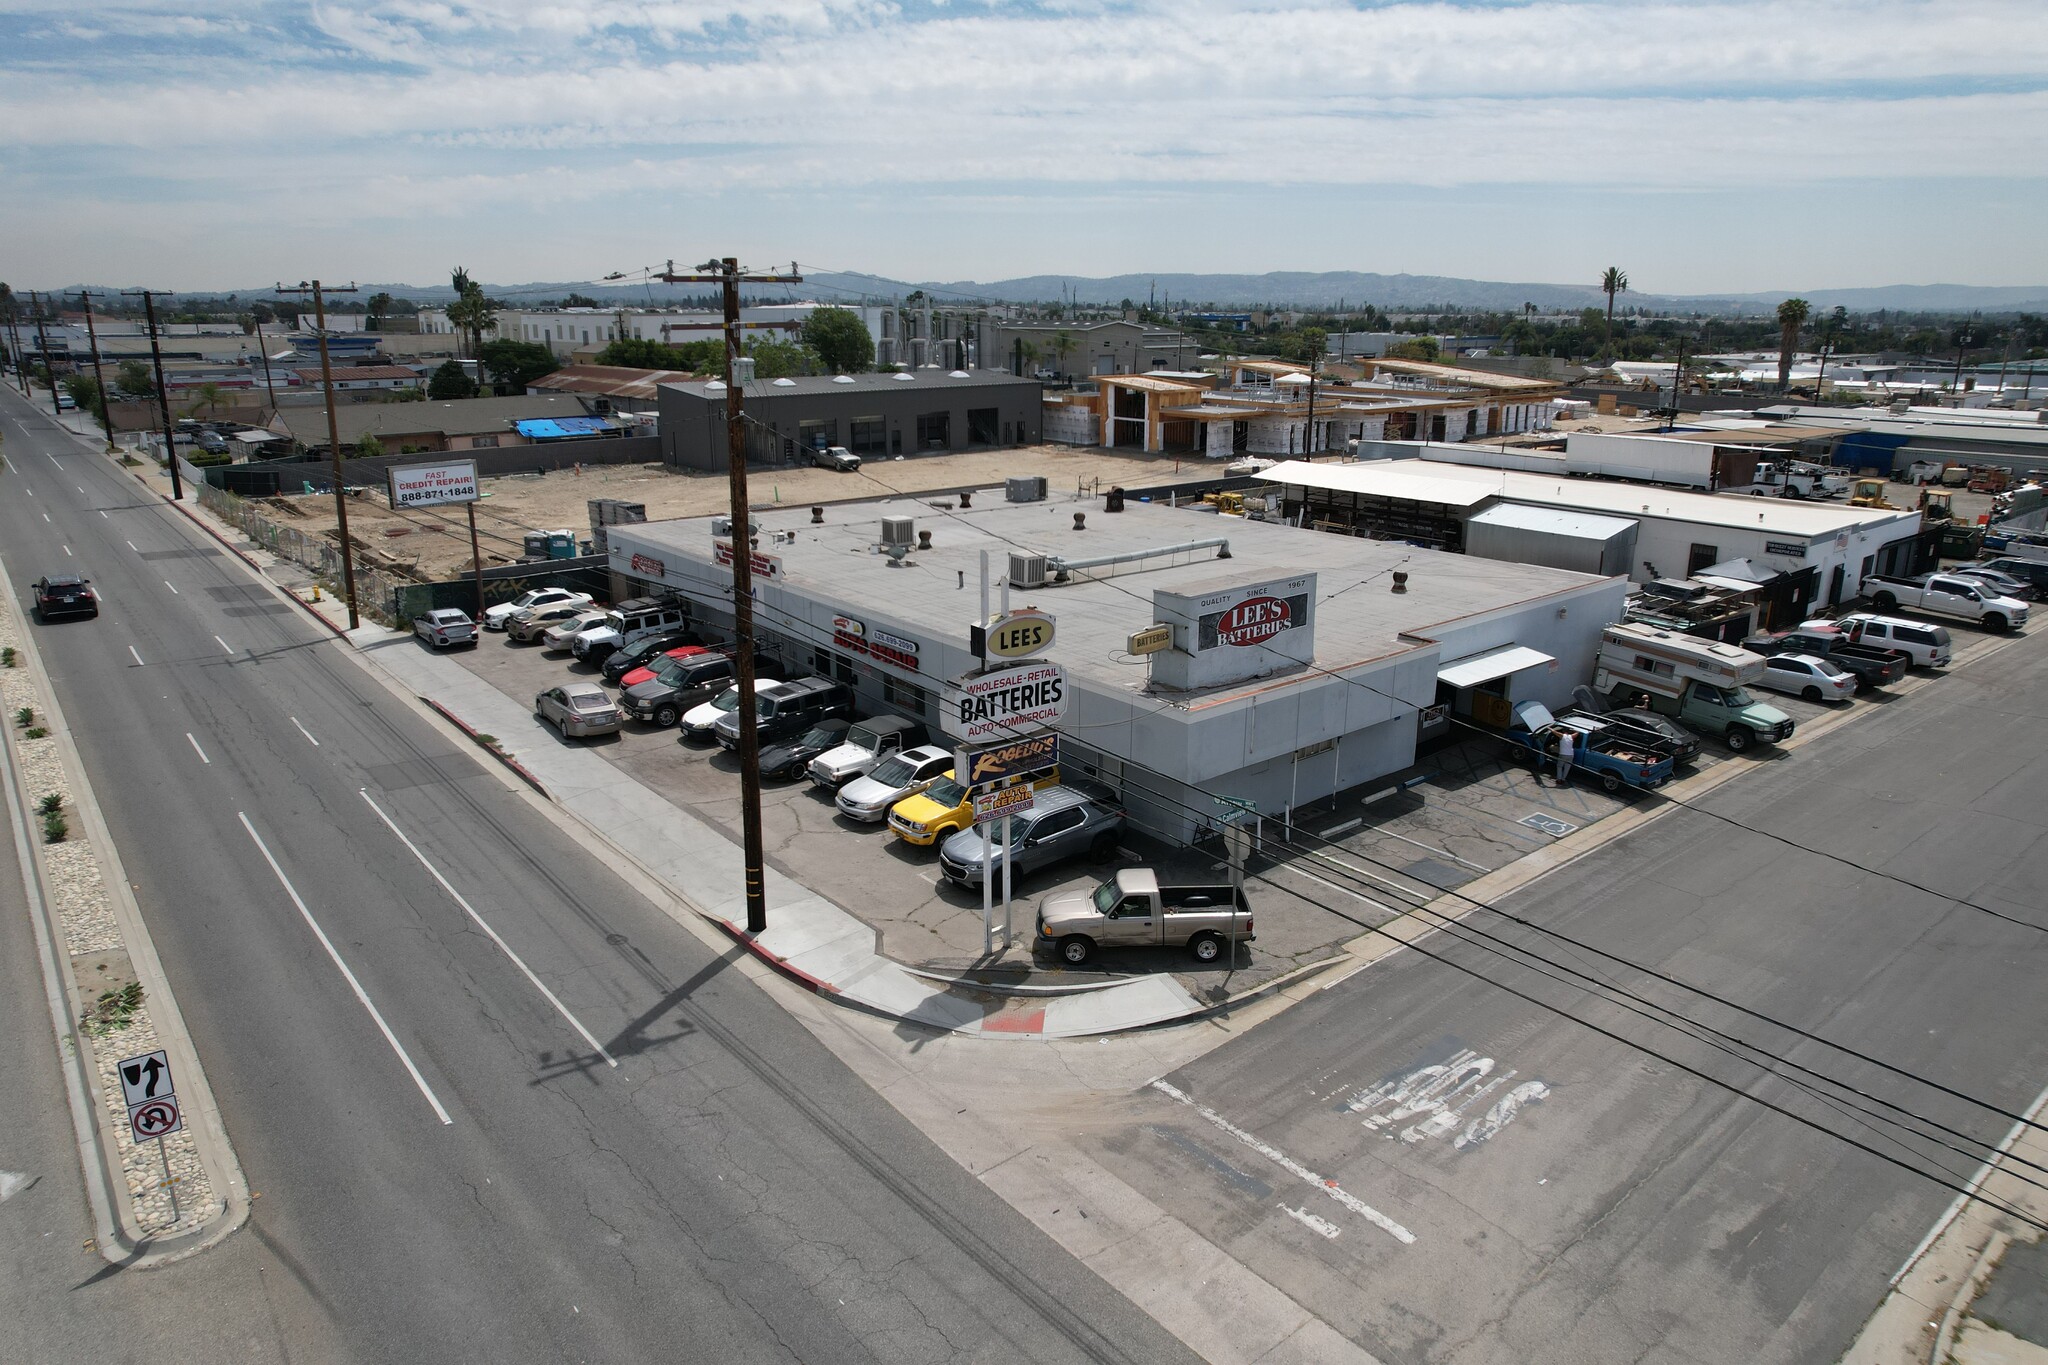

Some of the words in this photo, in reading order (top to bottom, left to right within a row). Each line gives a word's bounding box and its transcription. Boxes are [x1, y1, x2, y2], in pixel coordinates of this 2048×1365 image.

[399, 480, 433, 490] CREDIT
[436, 476, 473, 487] REPAIR!
[425, 470, 447, 480] FAST
[401, 486, 474, 502] 888-871-1848
[1200, 594, 1232, 607] QUALITY
[1246, 587, 1268, 597] SINCE
[1288, 580, 1306, 590] 1967
[1231, 600, 1283, 629] LEE'S
[1000, 626, 1042, 650] LEES
[1136, 629, 1170, 648] BATTERIES
[1216, 617, 1292, 646] BATTERIES
[833, 630, 868, 654] AUTO
[869, 642, 919, 673] REPAIR
[960, 678, 1063, 724] BATTERIES
[993, 790, 1033, 809] REPAIR
[997, 784, 1028, 799] AUTO
